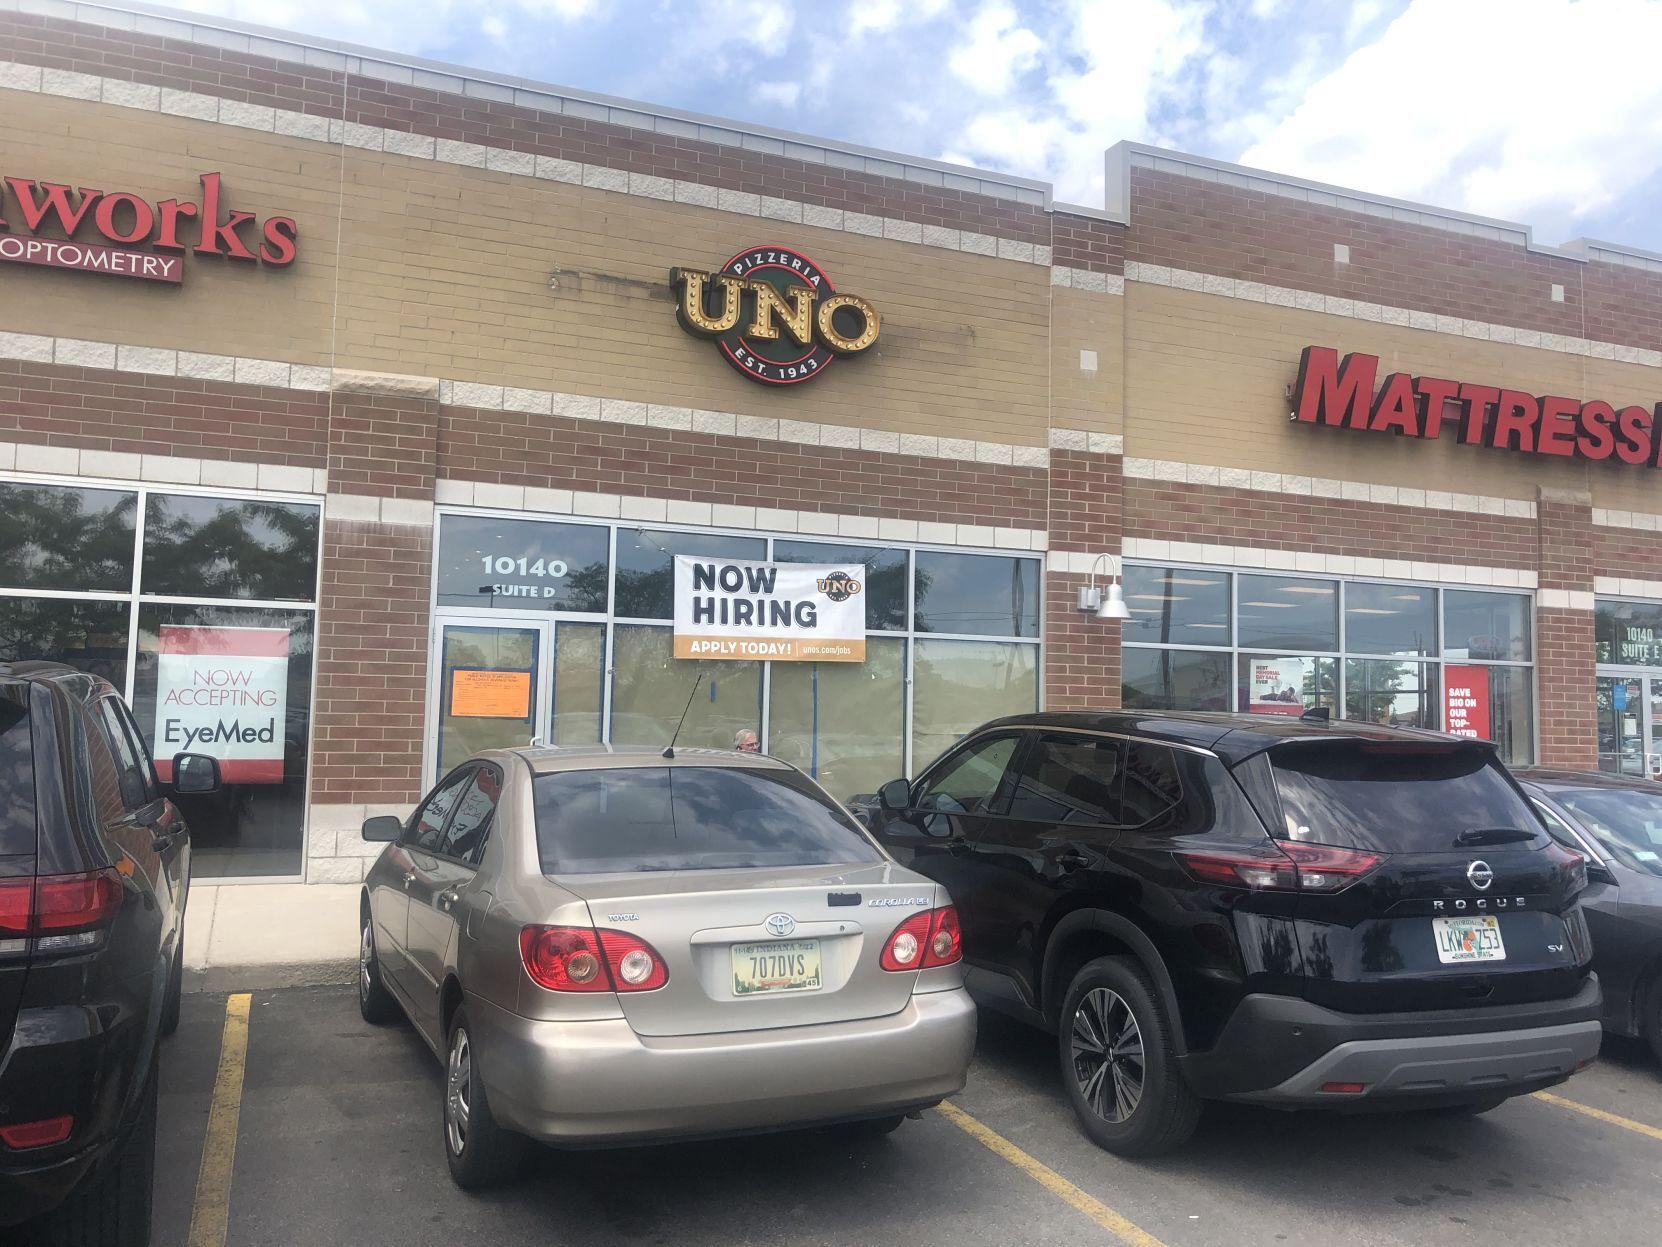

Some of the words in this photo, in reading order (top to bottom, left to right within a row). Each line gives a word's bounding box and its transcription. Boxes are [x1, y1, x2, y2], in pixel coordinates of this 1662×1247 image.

[0, 172, 297, 265] works
[0, 238, 174, 277] OPTOMETRY
[733, 252, 821, 287] PIZZERIA
[672, 267, 880, 352] UNO
[734, 347, 767, 376] EST.
[778, 358, 818, 379] 1943
[482, 555, 568, 578] 10140
[692, 563, 777, 595] NOW
[817, 578, 861, 594] UNO
[492, 584, 538, 598] SUITE
[543, 586, 556, 598] D
[692, 596, 818, 629] HIRING
[1627, 627, 1653, 642] 10140
[690, 640, 737, 653] APPLY
[740, 642, 791, 655] TODAY!
[1622, 643, 1650, 659] SUITE
[1654, 645, 1660, 659] E
[193, 669, 254, 687] NOW
[164, 688, 278, 707] ACCEPTING
[1449, 688, 1471, 697] SAVE
[1465, 699, 1477, 708] ON
[1450, 709, 1467, 718] OUR
[1450, 718, 1470, 728] TOP-
[164, 717, 275, 751] EyeMed
[868, 898, 914, 907] COROLLA
[1433, 897, 1526, 910] ROGUE
[608, 913, 640, 922] TOYOTA
[756, 944, 796, 954] INDIANA
[1547, 944, 1563, 953] SV
[749, 954, 805, 980] 707DVS
